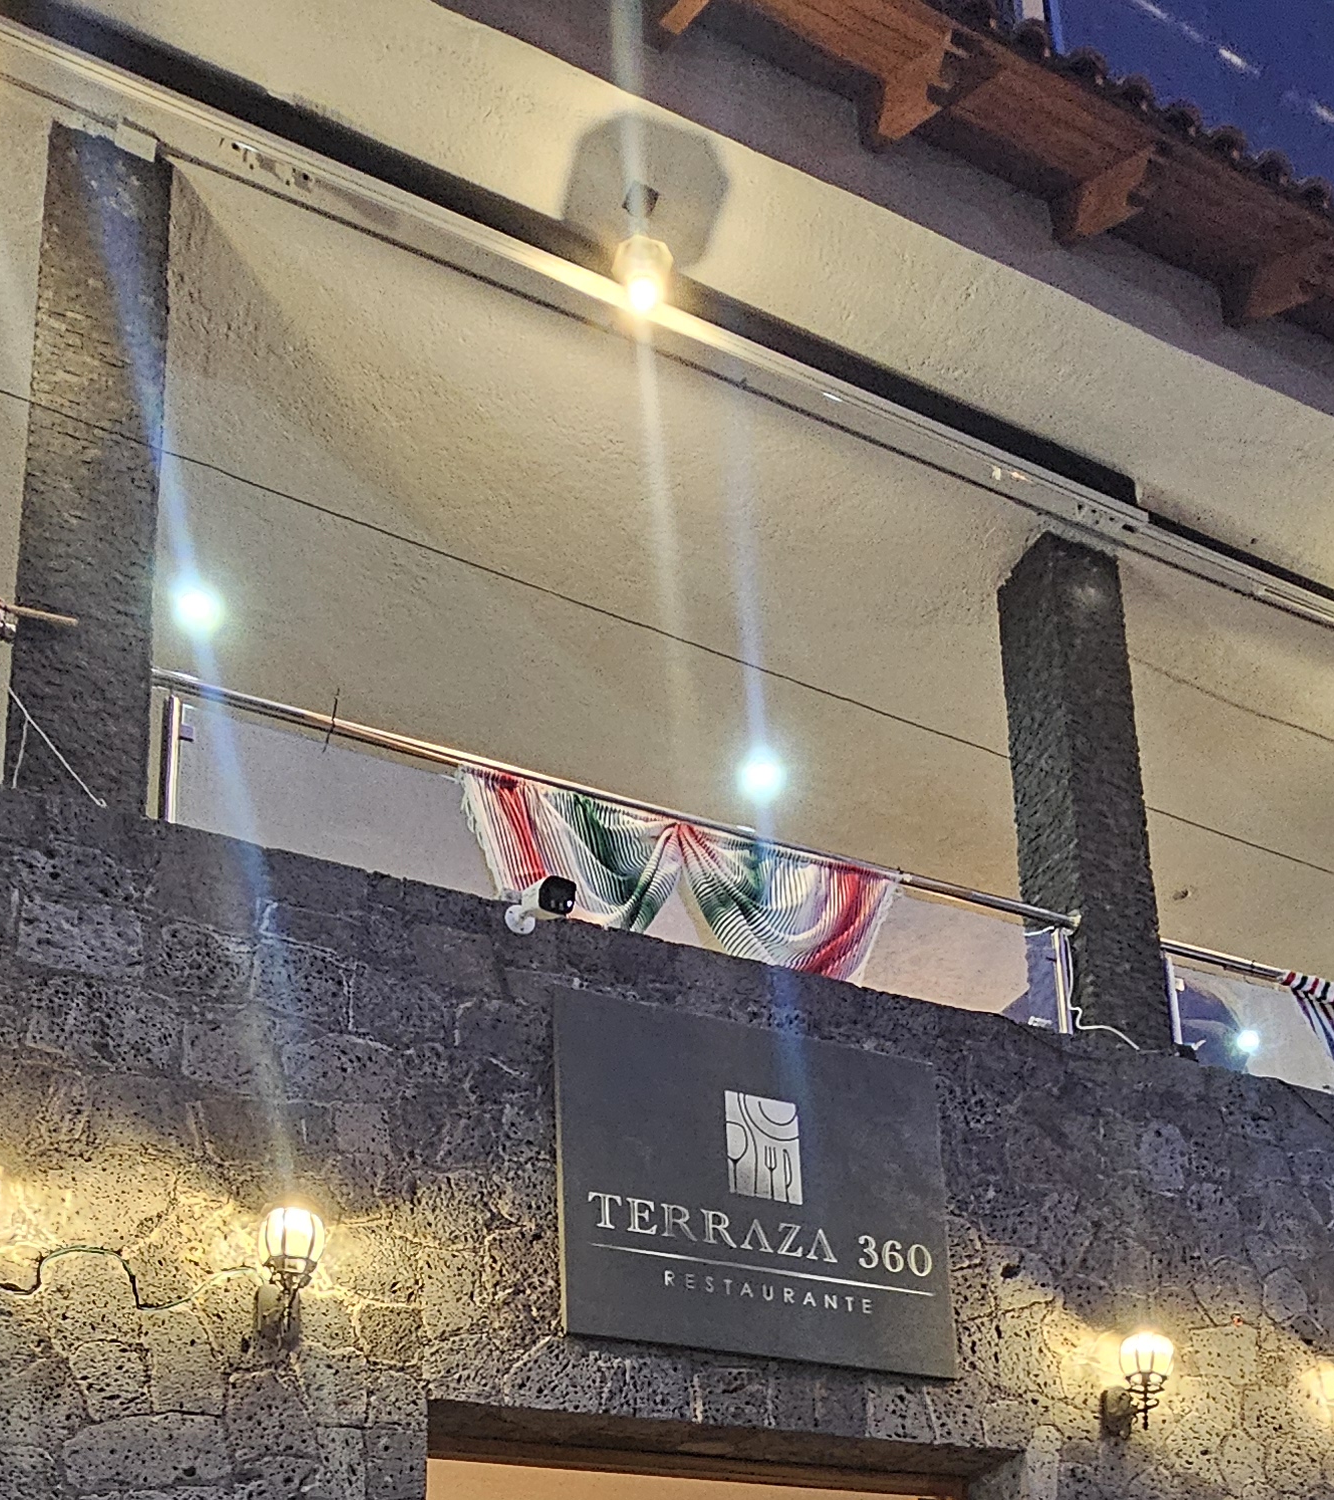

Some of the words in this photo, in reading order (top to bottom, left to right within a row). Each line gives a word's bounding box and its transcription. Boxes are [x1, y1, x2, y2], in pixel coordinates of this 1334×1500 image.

[588, 1192, 838, 1263] TERRAZA
[857, 1235, 932, 1277] 360
[664, 1270, 873, 1314] RESTAURANTE
